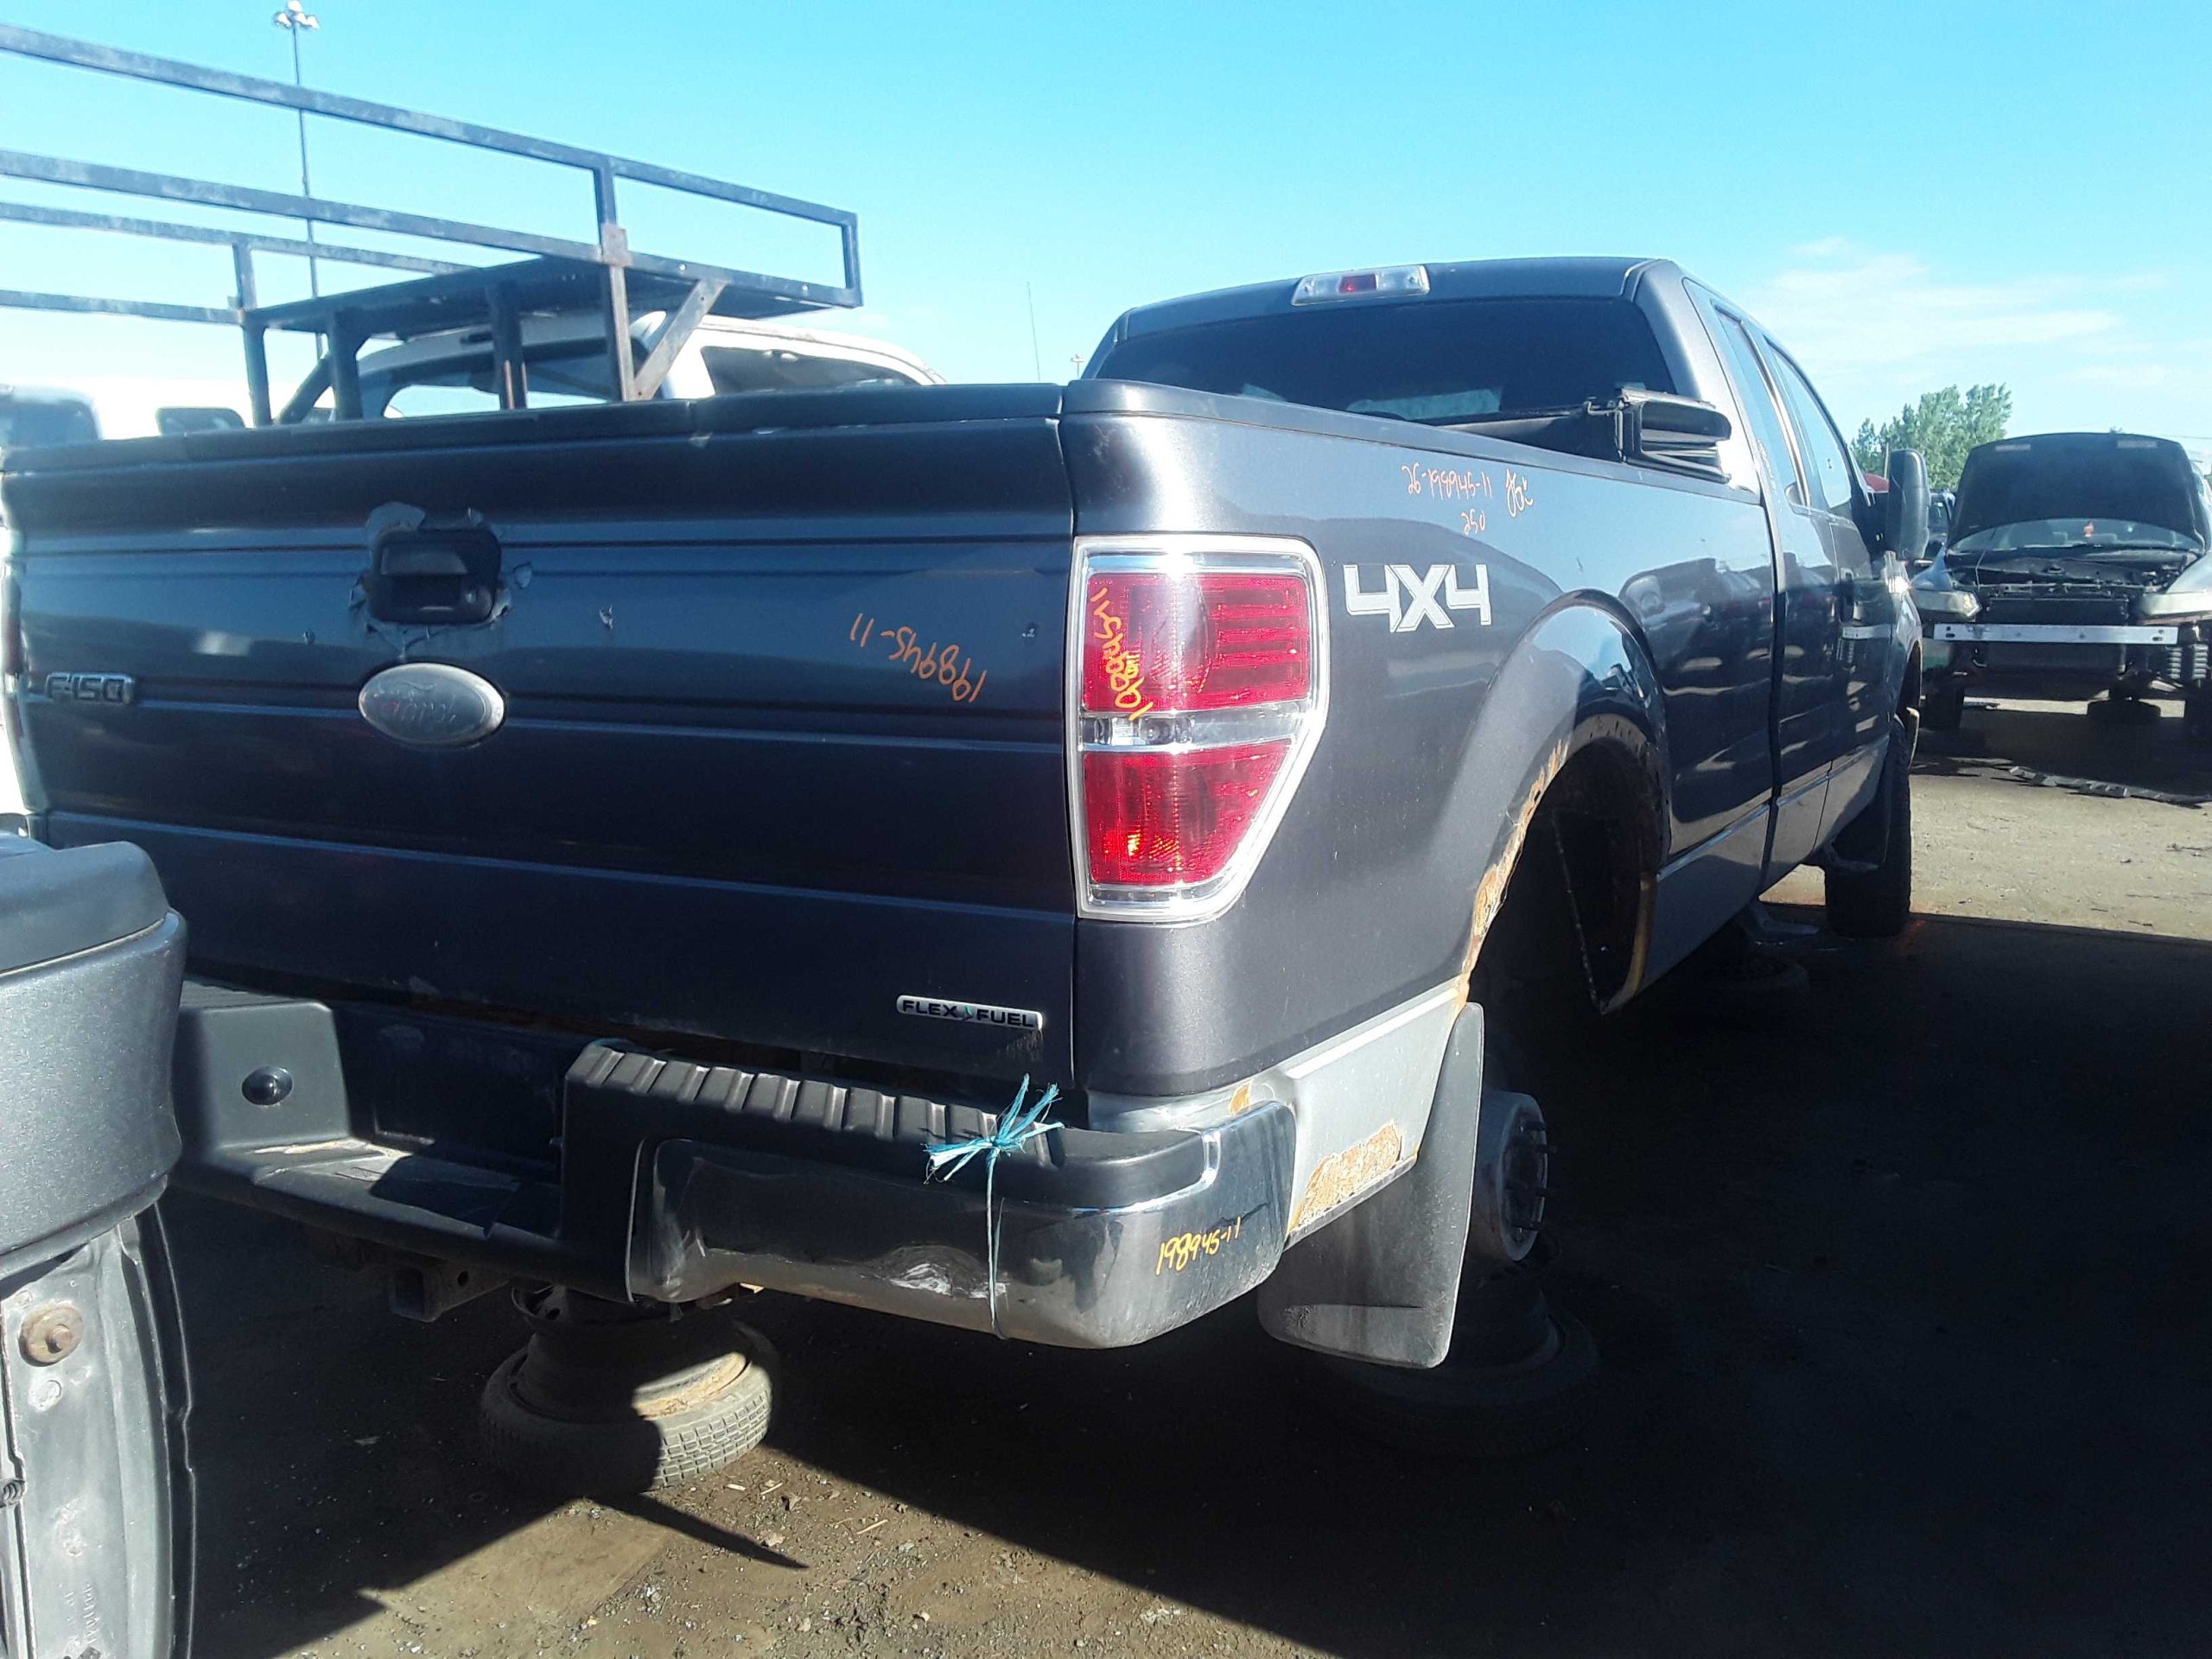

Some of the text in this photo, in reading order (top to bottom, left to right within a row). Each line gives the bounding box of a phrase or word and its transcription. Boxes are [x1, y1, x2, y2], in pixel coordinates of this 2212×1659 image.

[1343, 563, 1493, 633] 4X4
[901, 999, 1034, 1028] FLEX FUEL
[1154, 1216, 1242, 1277] 198945-11
